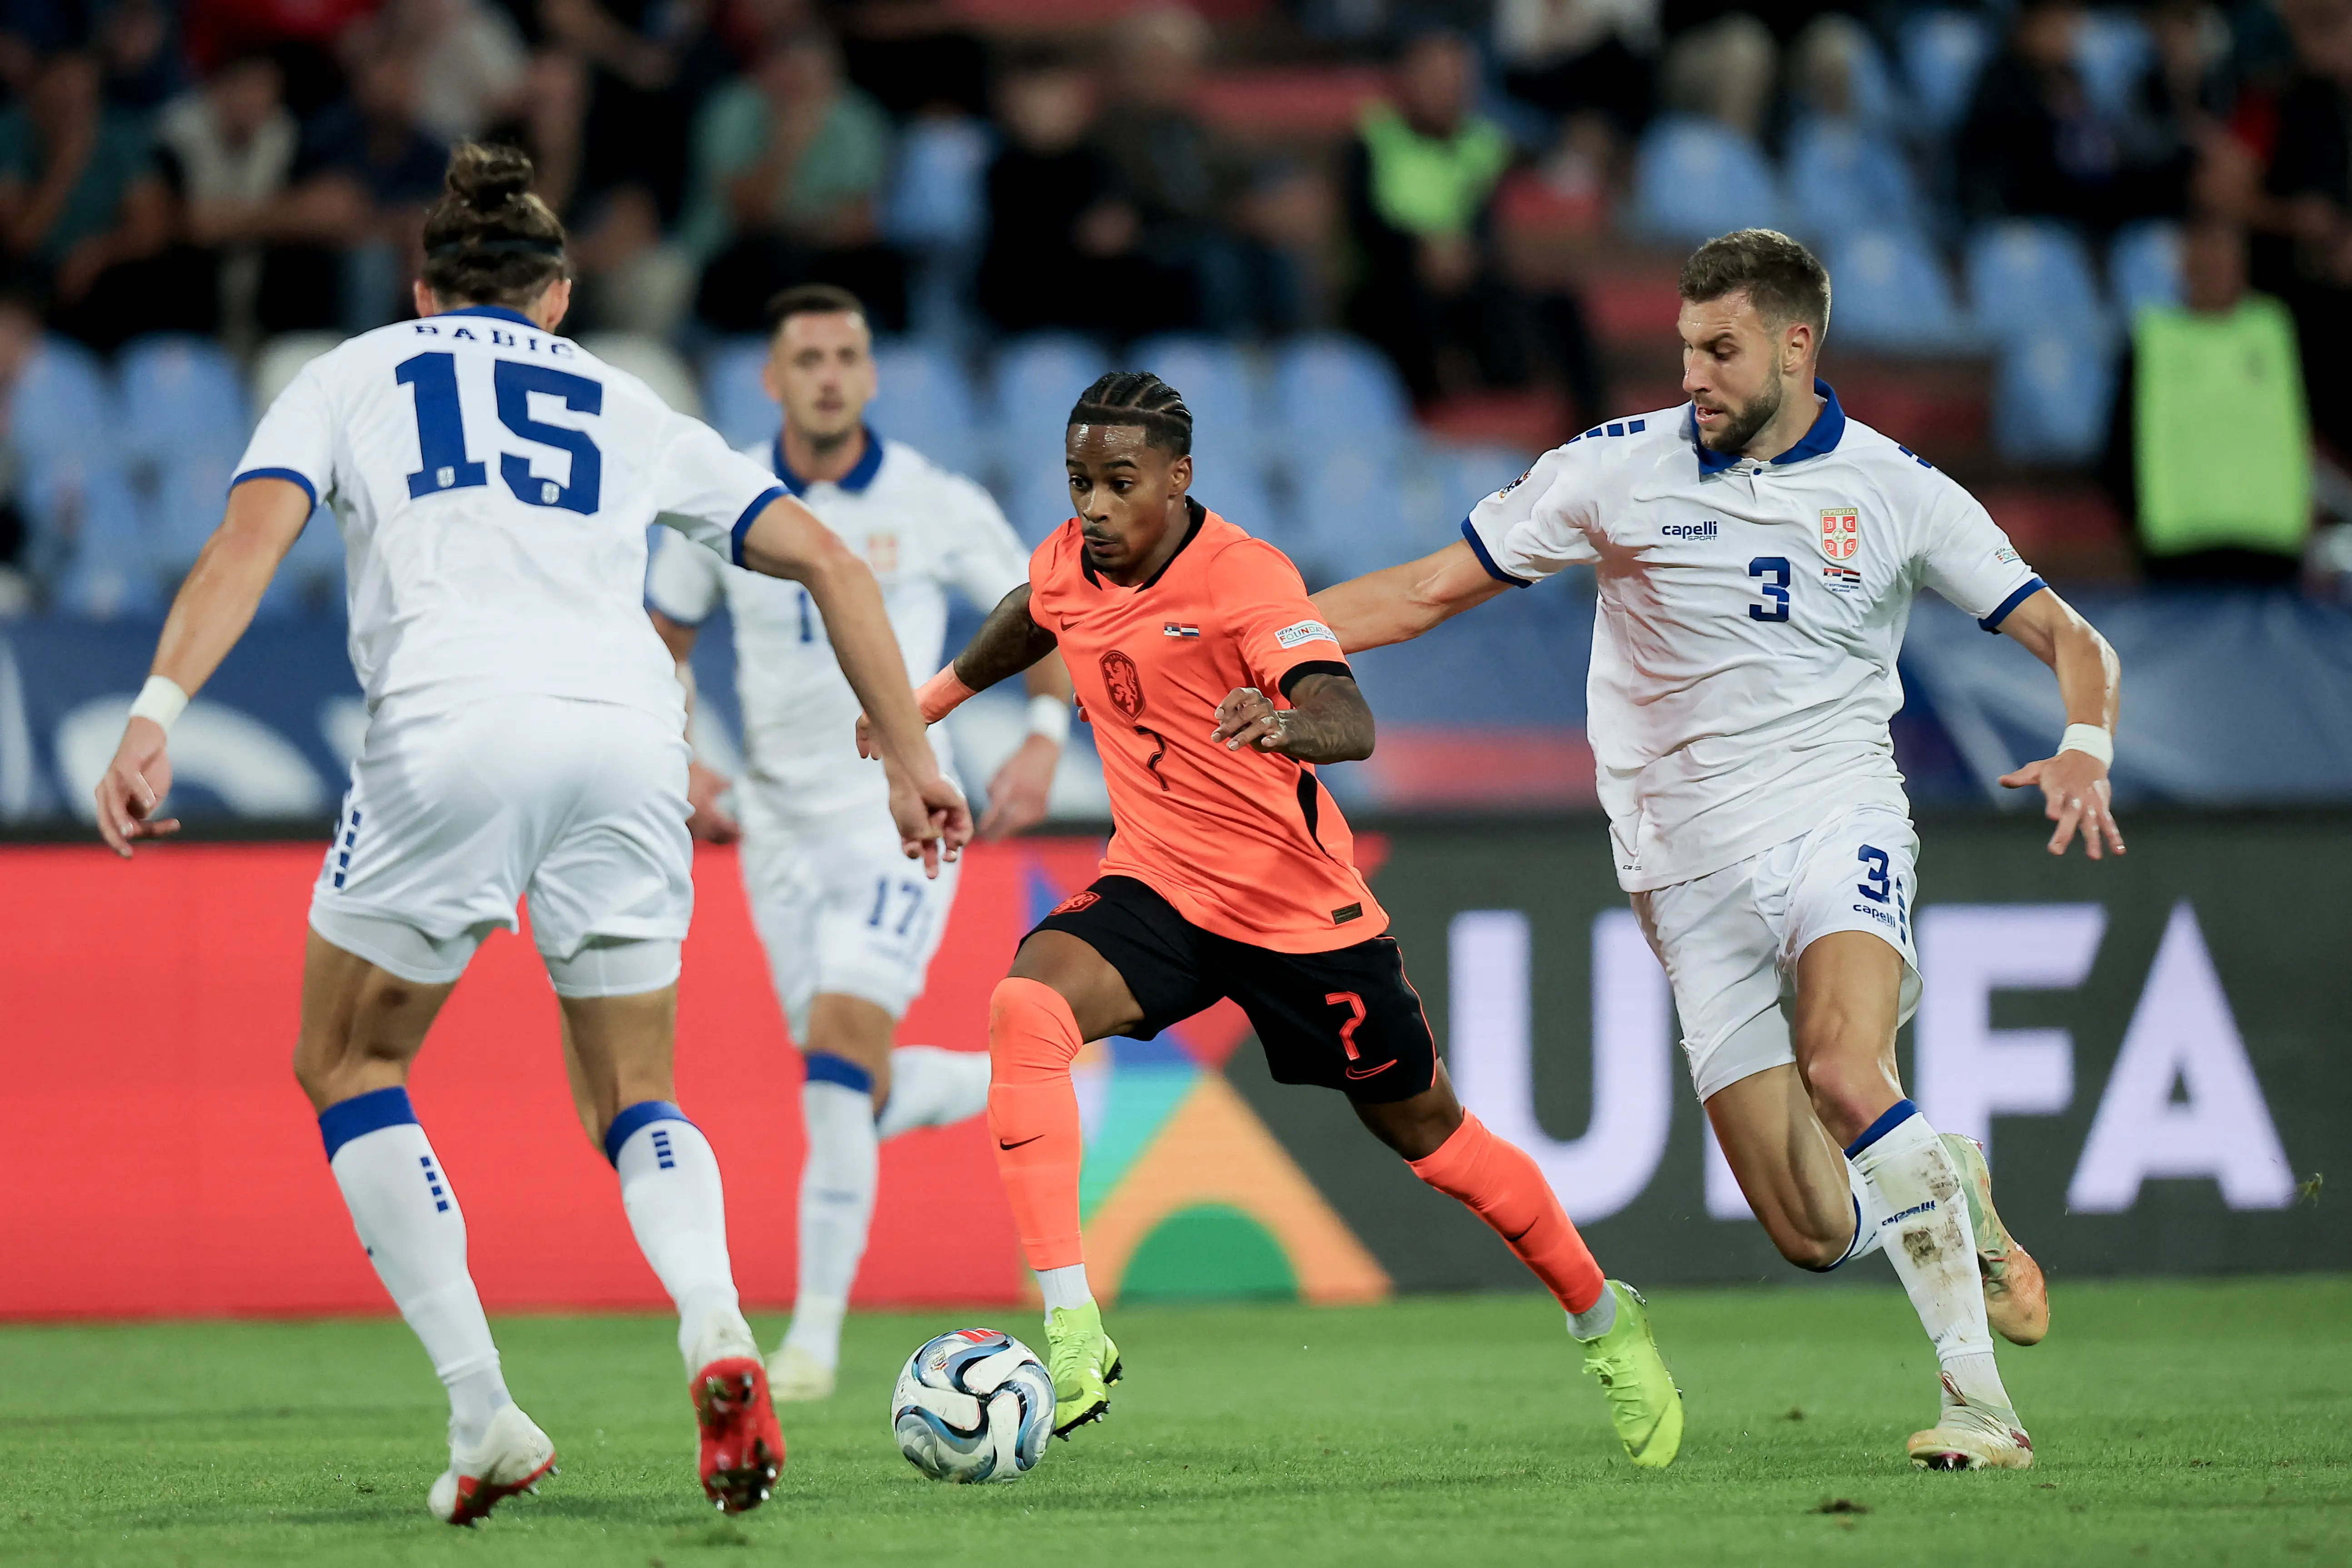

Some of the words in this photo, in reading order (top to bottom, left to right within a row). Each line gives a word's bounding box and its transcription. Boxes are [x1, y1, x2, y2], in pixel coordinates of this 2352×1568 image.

[395, 352, 603, 515] 15
[1662, 521, 1717, 539] capelli
[798, 591, 813, 643] 1
[1749, 557, 1791, 622] 3
[1135, 725, 1170, 791] 7
[867, 876, 923, 935] 17
[1858, 844, 1890, 905] 3
[1853, 905, 1895, 927] capelli
[1325, 991, 1365, 1060] 7
[1450, 899, 2296, 1225] UFA
